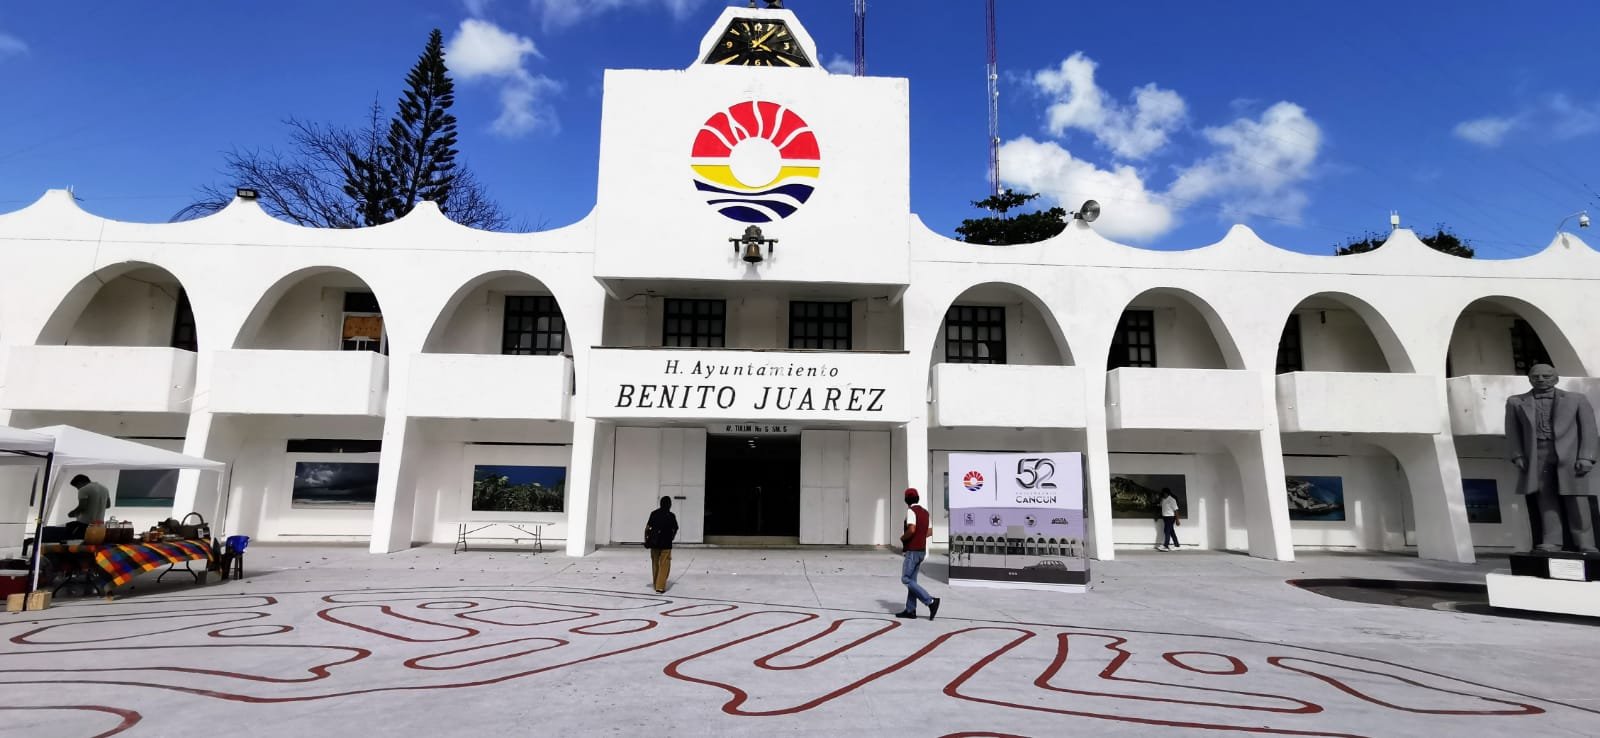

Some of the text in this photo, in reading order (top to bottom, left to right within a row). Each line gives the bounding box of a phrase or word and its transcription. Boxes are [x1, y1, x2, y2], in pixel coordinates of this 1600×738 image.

[663, 359, 839, 378] H. Ayuntamiento
[614, 384, 736, 409] BENITO
[1016, 458, 1057, 489] 52
